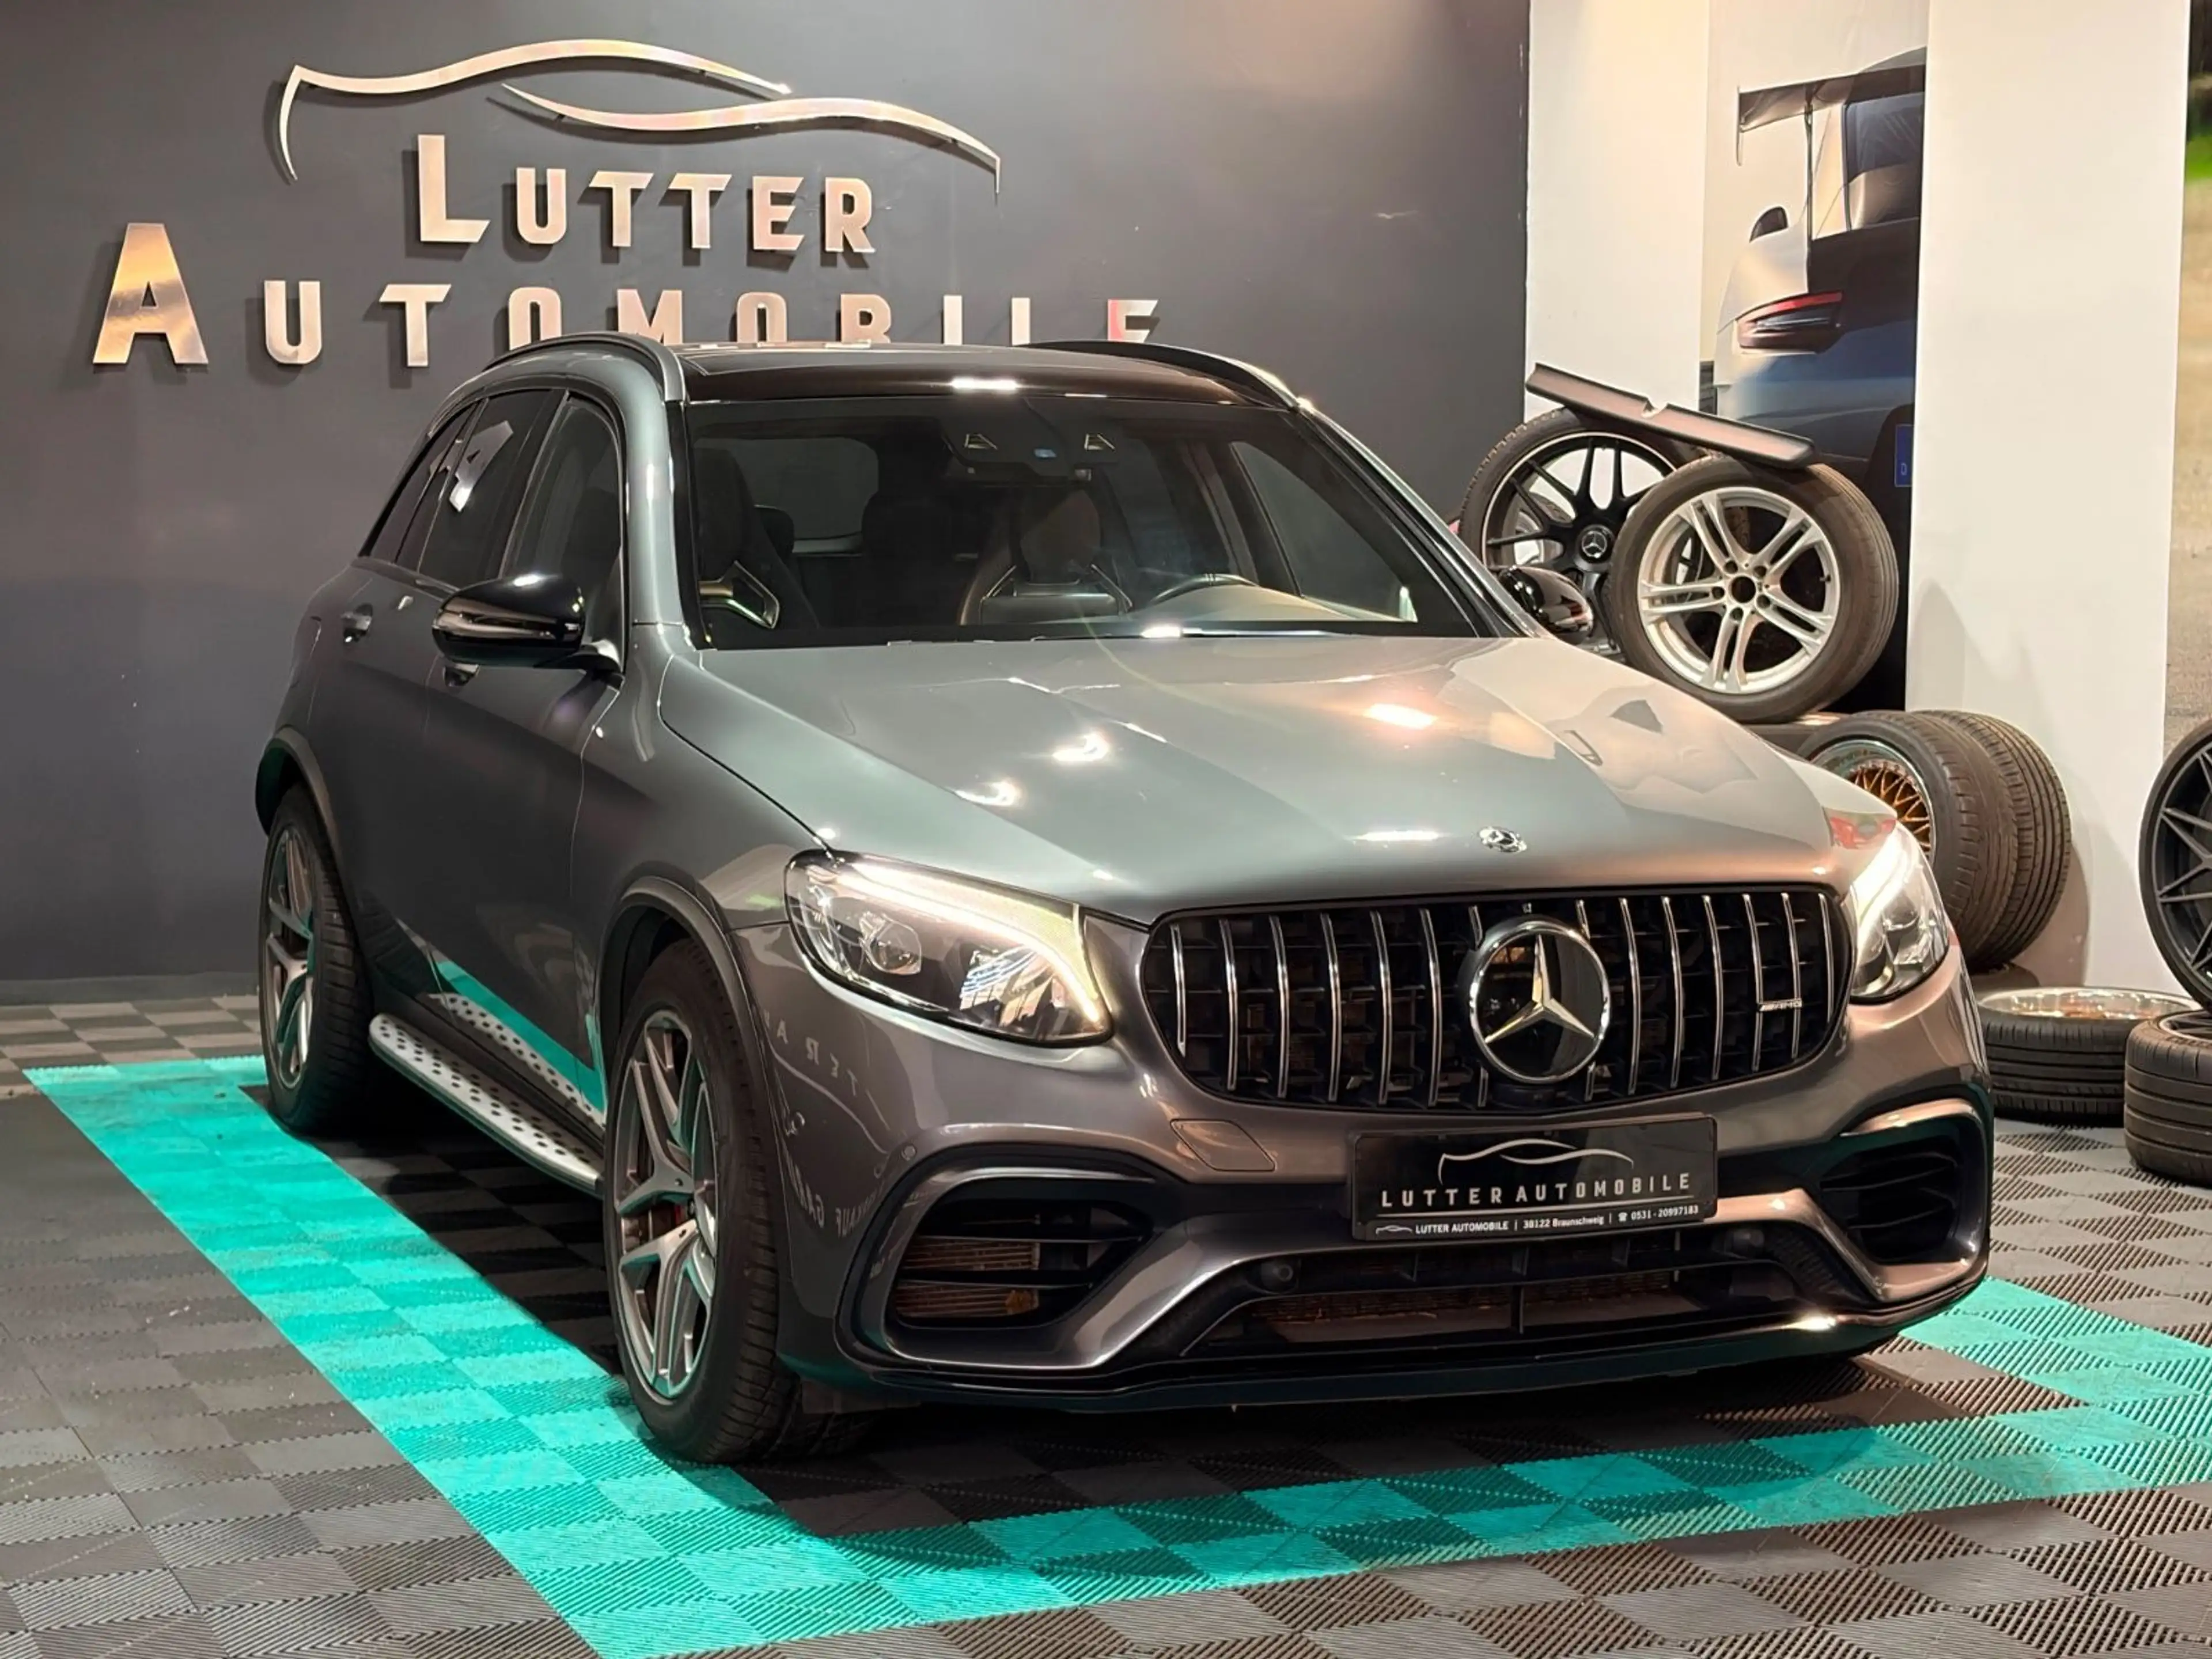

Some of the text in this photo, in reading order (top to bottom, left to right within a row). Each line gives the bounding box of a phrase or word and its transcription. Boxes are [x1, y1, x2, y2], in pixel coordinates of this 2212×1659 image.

[418, 134, 875, 253] LUTTER
[1382, 1173, 1689, 1207] LUTTER AUTOMOBILE
[1415, 1224, 1449, 1234] LUTTER
[1451, 1220, 1508, 1233] AUTOMOBILE
[1552, 1214, 1604, 1228] Braunschweig
[1631, 1209, 1652, 1220] 0531
